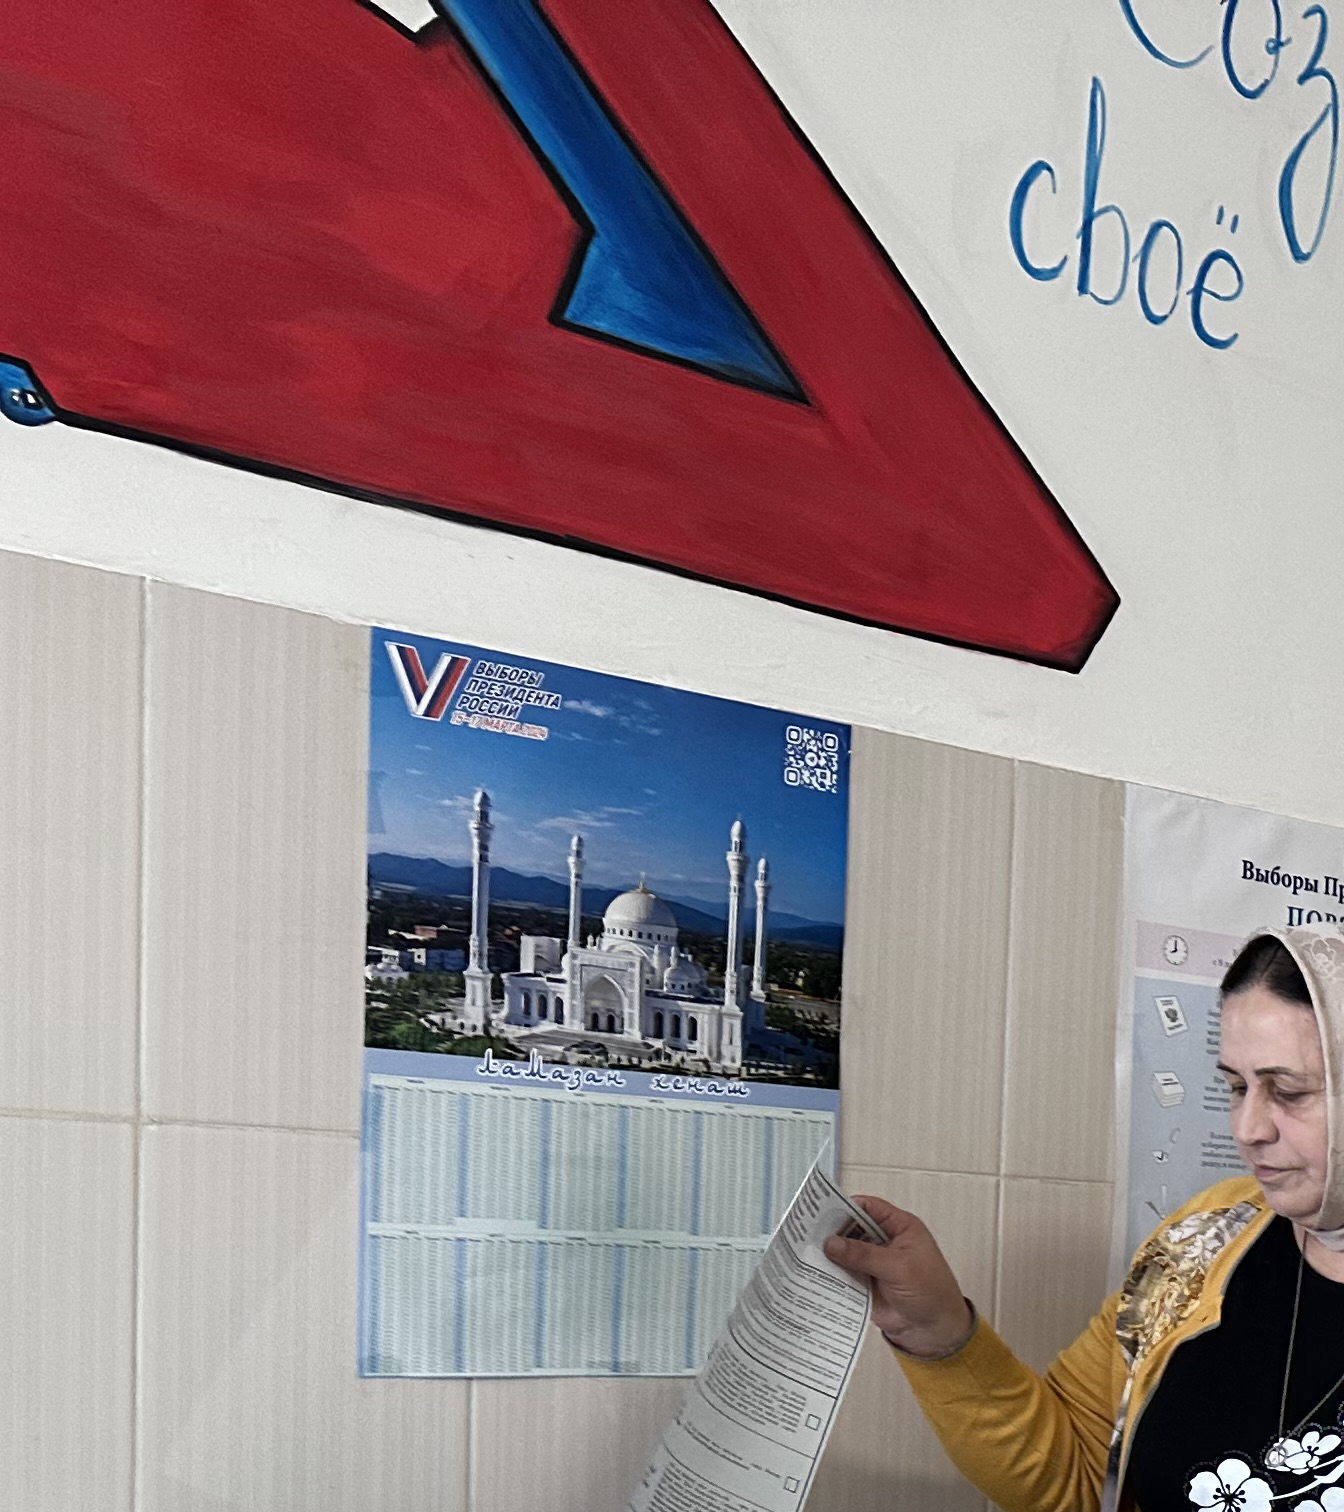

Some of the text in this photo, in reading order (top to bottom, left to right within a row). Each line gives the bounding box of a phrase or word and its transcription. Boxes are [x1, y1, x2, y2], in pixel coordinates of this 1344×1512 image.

[1009, 76, 1244, 349] своё
[475, 661, 542, 686] ВЫБОРЫ
[457, 696, 520, 718] РОССИИ
[465, 679, 562, 709] ПРЕЗИДЕНТА
[1241, 859, 1319, 896] Выборы
